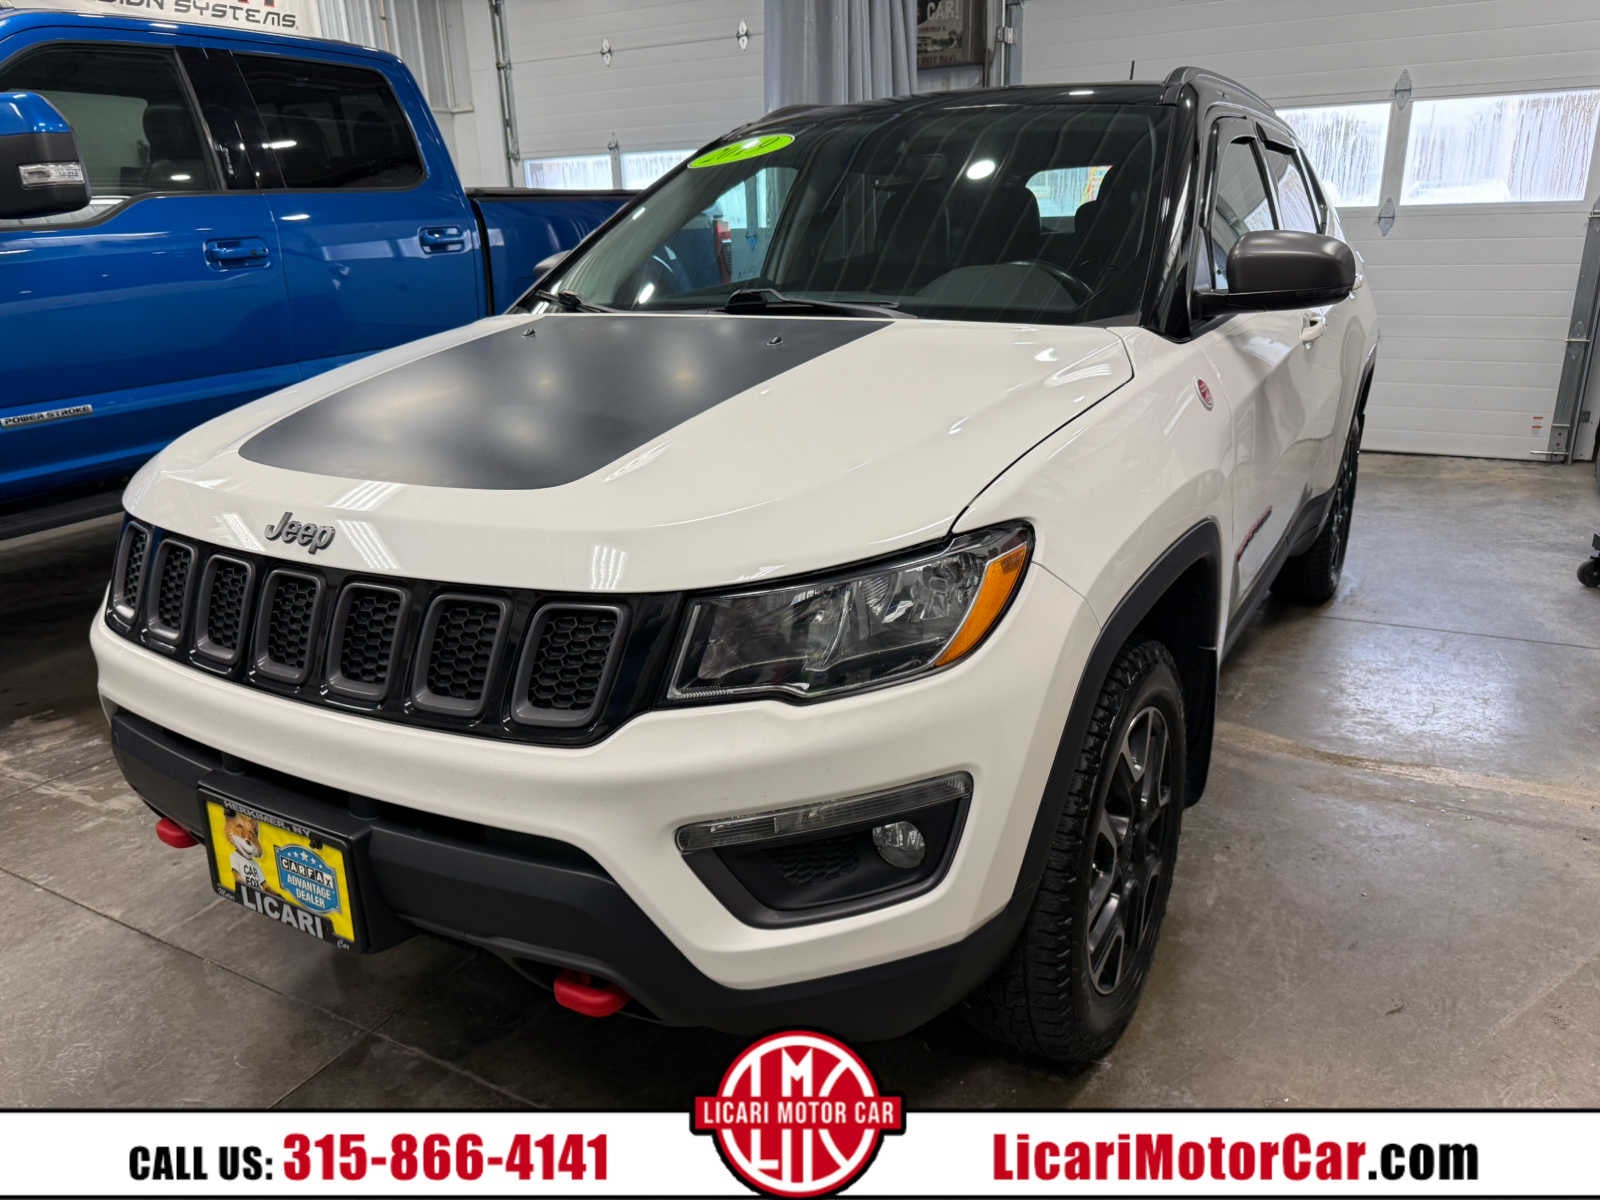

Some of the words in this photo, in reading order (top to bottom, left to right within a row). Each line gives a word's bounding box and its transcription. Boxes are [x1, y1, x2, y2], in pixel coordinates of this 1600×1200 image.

[4, 413, 45, 425] POWER
[46, 405, 90, 418] STROKE
[264, 511, 336, 555] Jeep
[243, 864, 258, 878] CAR
[281, 858, 334, 889] CARFAX
[287, 873, 332, 901] ADVANTAGE
[296, 888, 326, 909] DEALER
[240, 885, 324, 939] LICARI
